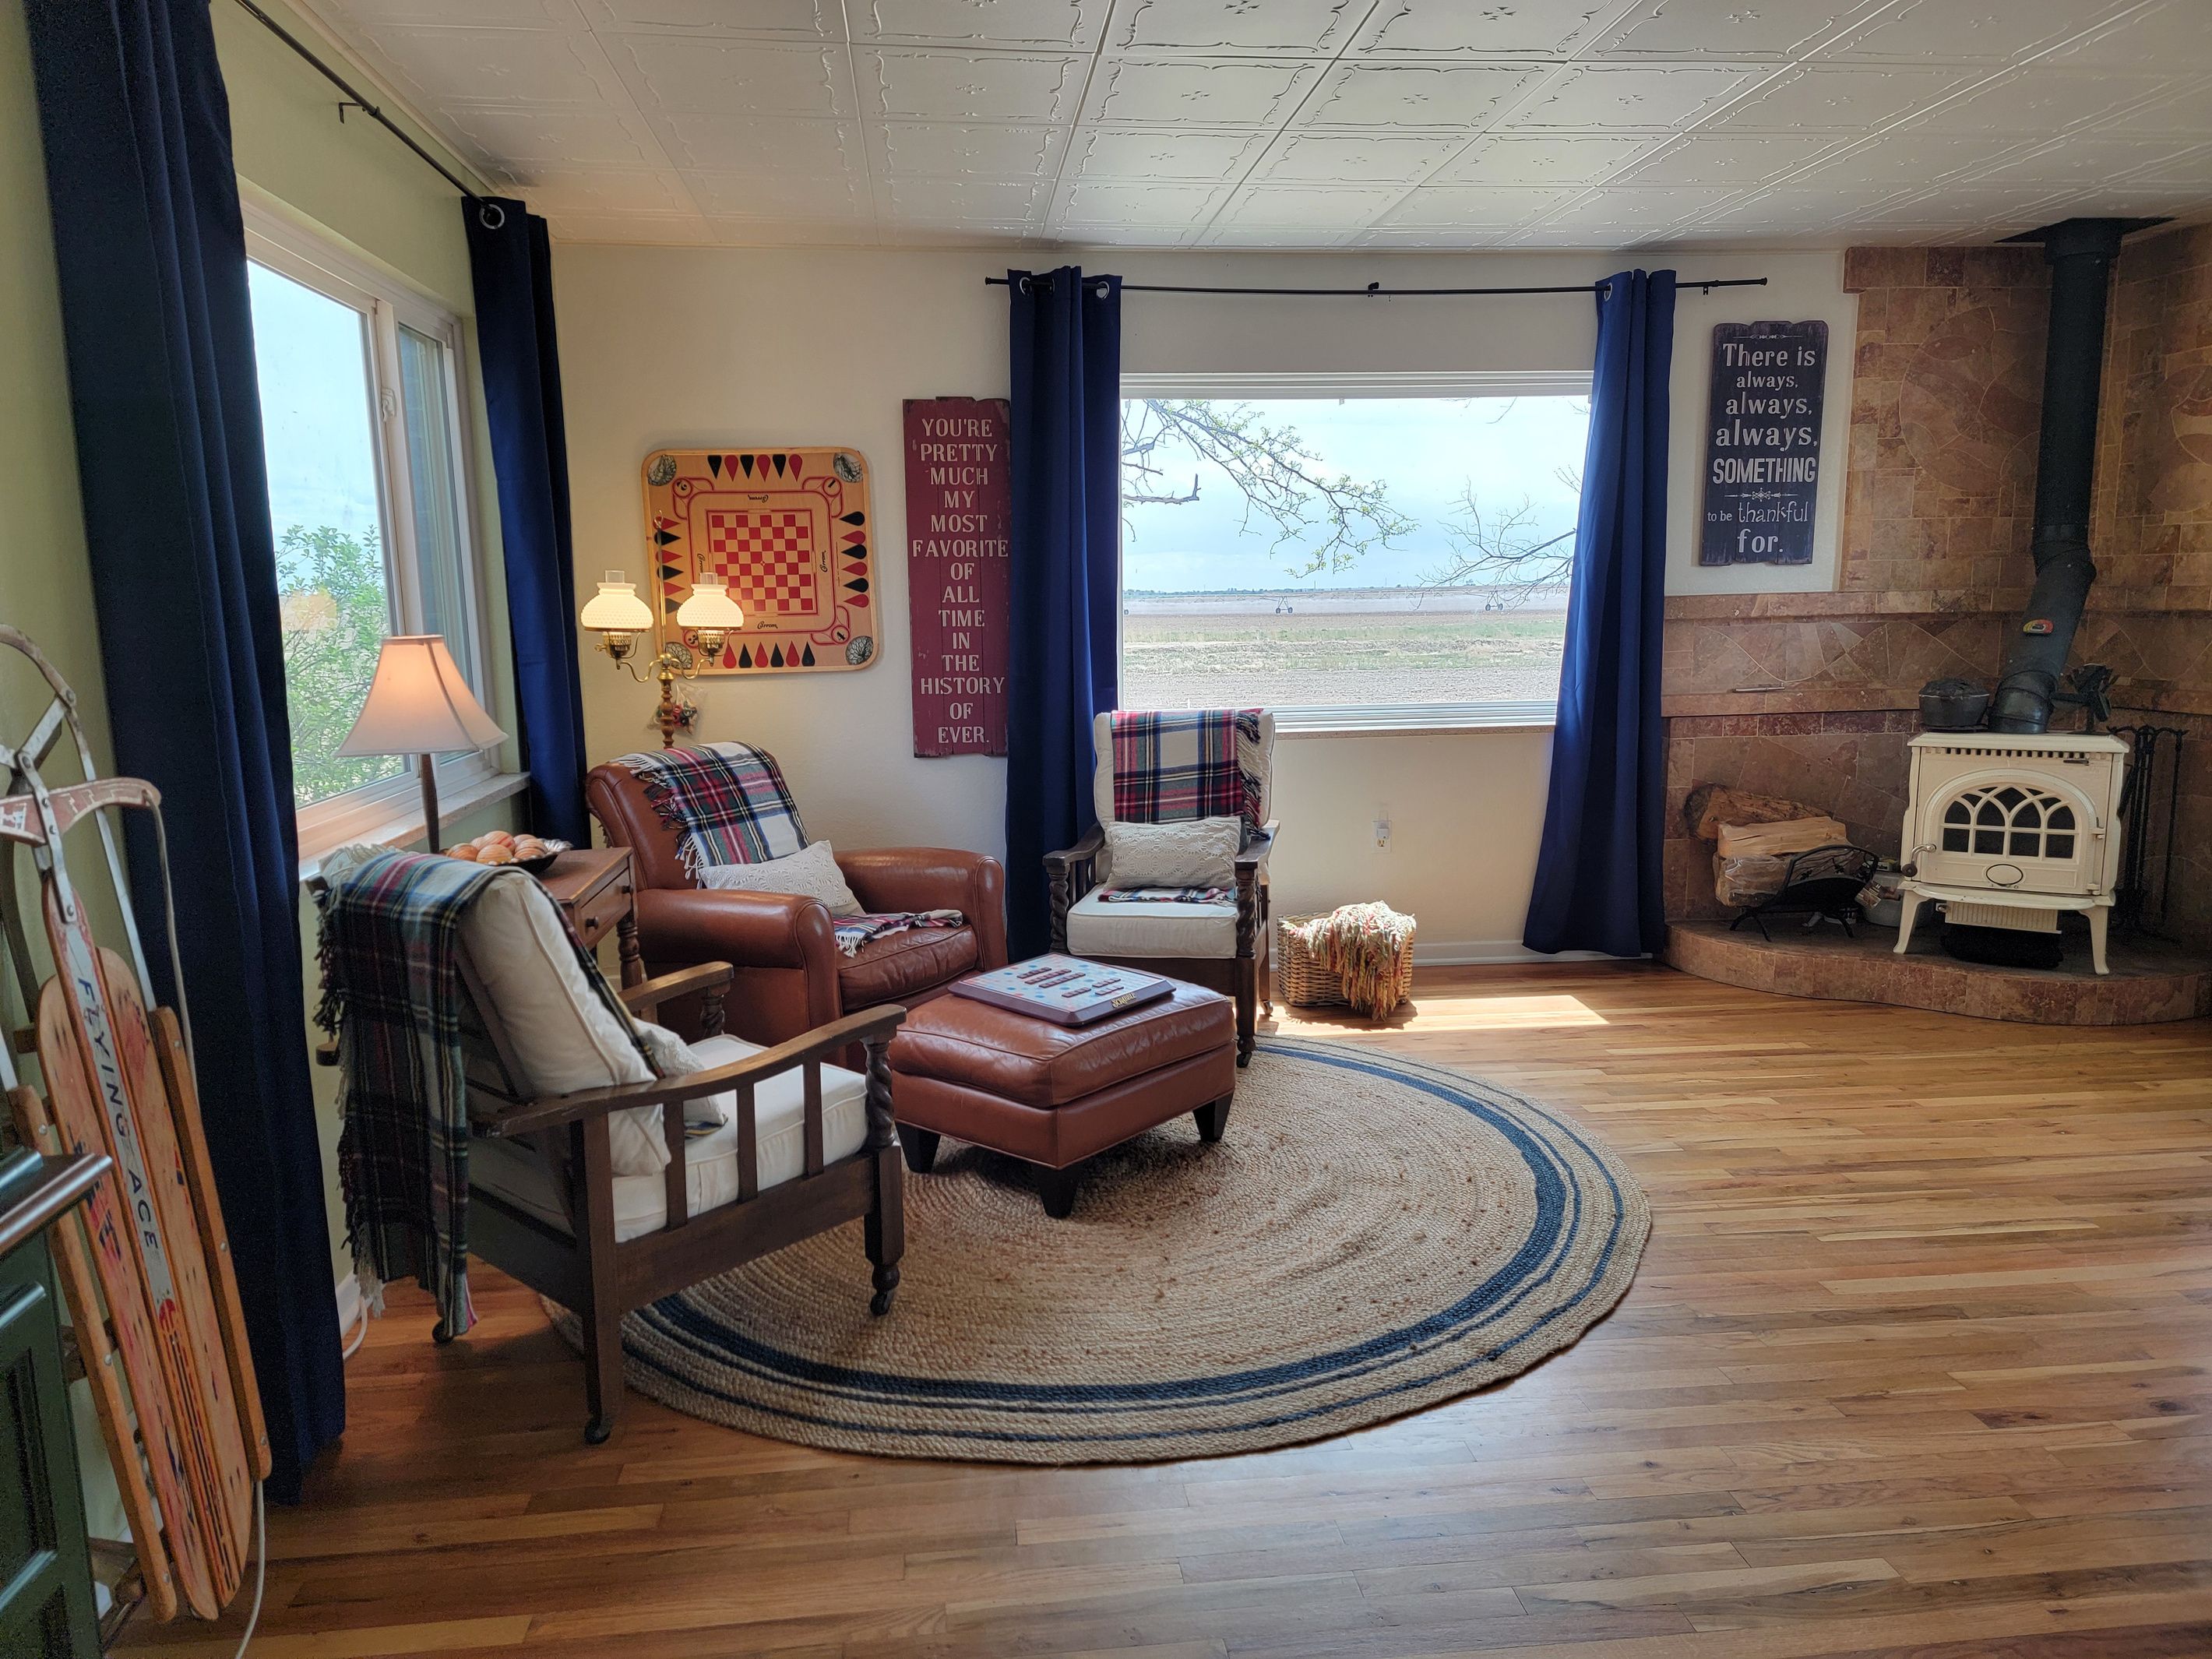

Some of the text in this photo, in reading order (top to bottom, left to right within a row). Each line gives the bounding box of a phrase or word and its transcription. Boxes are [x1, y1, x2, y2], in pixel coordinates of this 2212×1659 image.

[1722, 343, 1816, 367] There is
[1736, 371, 1798, 391] always,
[1725, 391, 1812, 419] always,
[921, 418, 993, 438] YOU'RE
[1715, 418, 1818, 452] always,
[920, 443, 998, 463] PRETTY
[930, 467, 988, 486] MUCH
[1712, 456, 1816, 484] SOMETHING
[944, 490, 976, 509] MY
[1707, 501, 1809, 523] to be thankful
[930, 514, 988, 533] MOST
[912, 539, 1009, 558] FAVORITE
[1737, 528, 1784, 554] for.
[949, 562, 975, 580] OF
[942, 585, 980, 604] ALL
[938, 609, 985, 628] TIME
[952, 632, 970, 650] IN
[942, 654, 980, 671] THE
[920, 676, 1006, 695] HISTORY
[949, 702, 974, 720] OF
[938, 726, 990, 744] EVER.
[78, 977, 159, 1251] FLYING ACE
